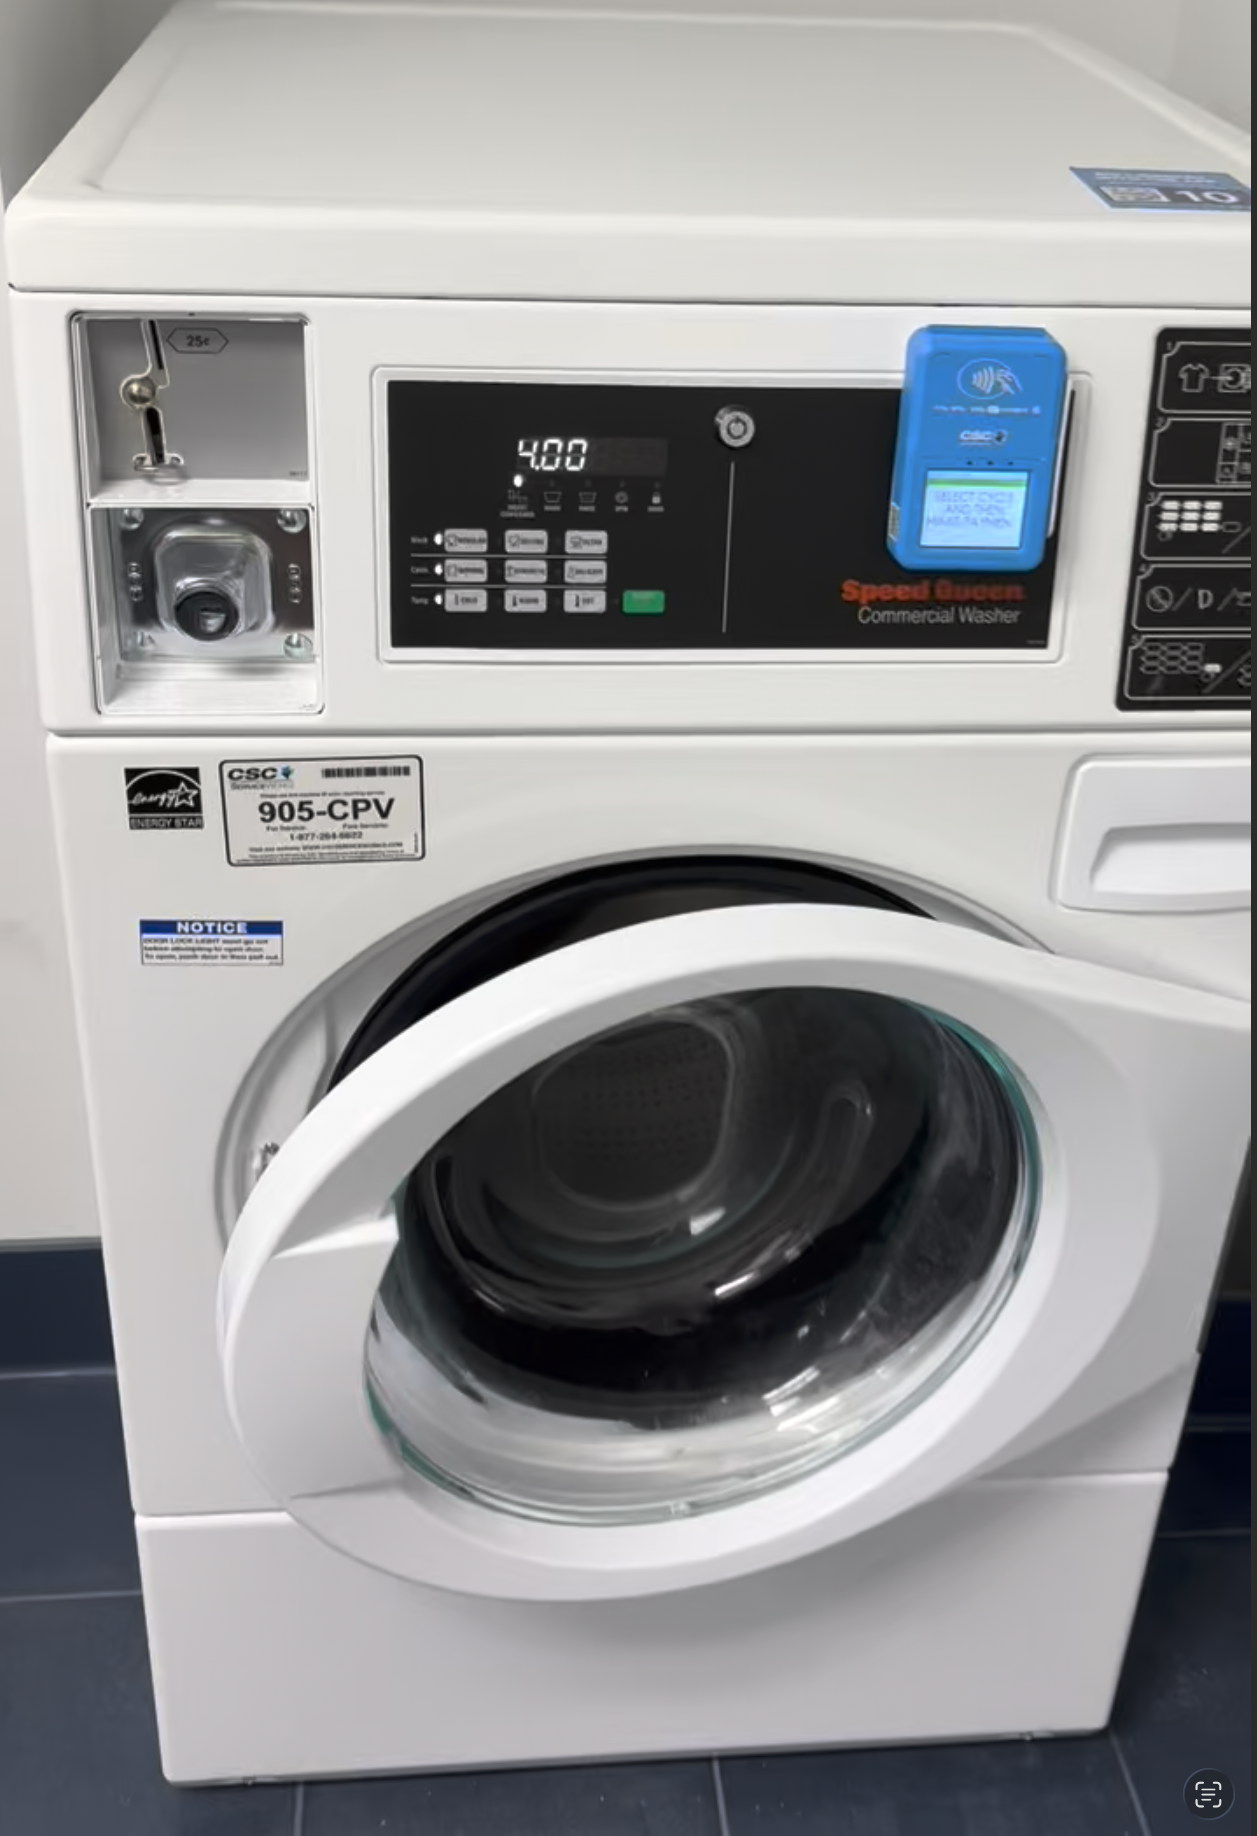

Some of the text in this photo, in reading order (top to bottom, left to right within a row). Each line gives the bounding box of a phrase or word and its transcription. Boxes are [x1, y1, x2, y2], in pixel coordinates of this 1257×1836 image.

[1174, 190, 1239, 204] 10
[518, 438, 589, 472] 4.00
[841, 578, 1025, 605] Speed Queen
[858, 606, 1022, 624] Commercial Washer
[228, 767, 278, 782] CSC
[258, 798, 395, 823] 905-CPV
[130, 818, 203, 828] ENERGY STAR
[176, 921, 248, 934] NOTICE
